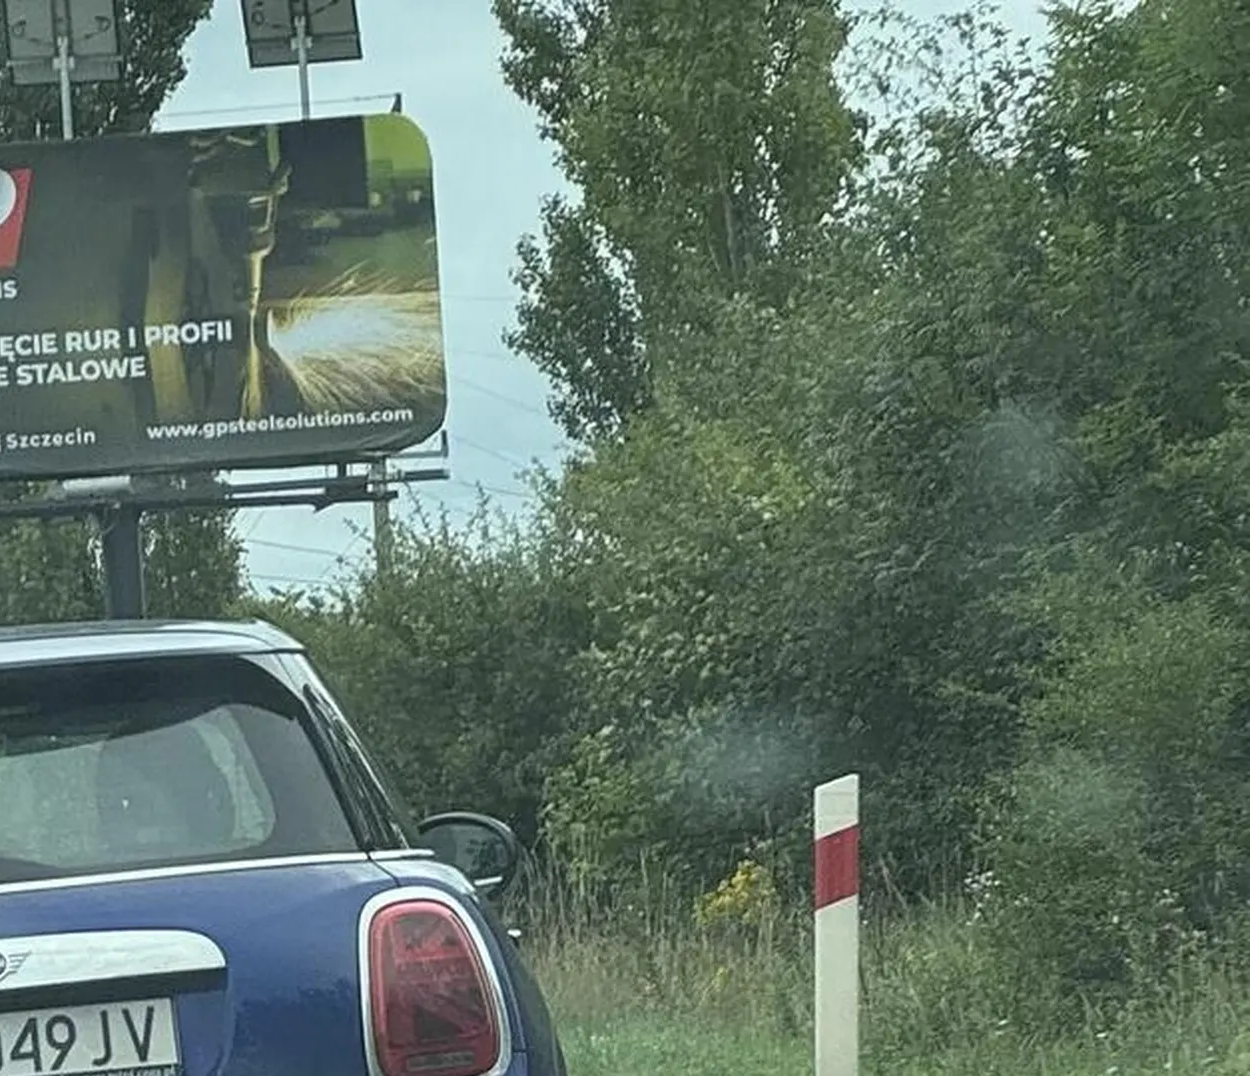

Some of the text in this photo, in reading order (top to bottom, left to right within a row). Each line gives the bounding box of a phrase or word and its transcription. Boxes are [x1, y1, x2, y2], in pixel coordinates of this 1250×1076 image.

[65, 328, 121, 353] RUR
[128, 326, 137, 349] I
[16, 356, 147, 386] STALOWE
[146, 408, 414, 439] www.gpsteelsolutions.com
[6, 427, 96, 450] Szczecin
